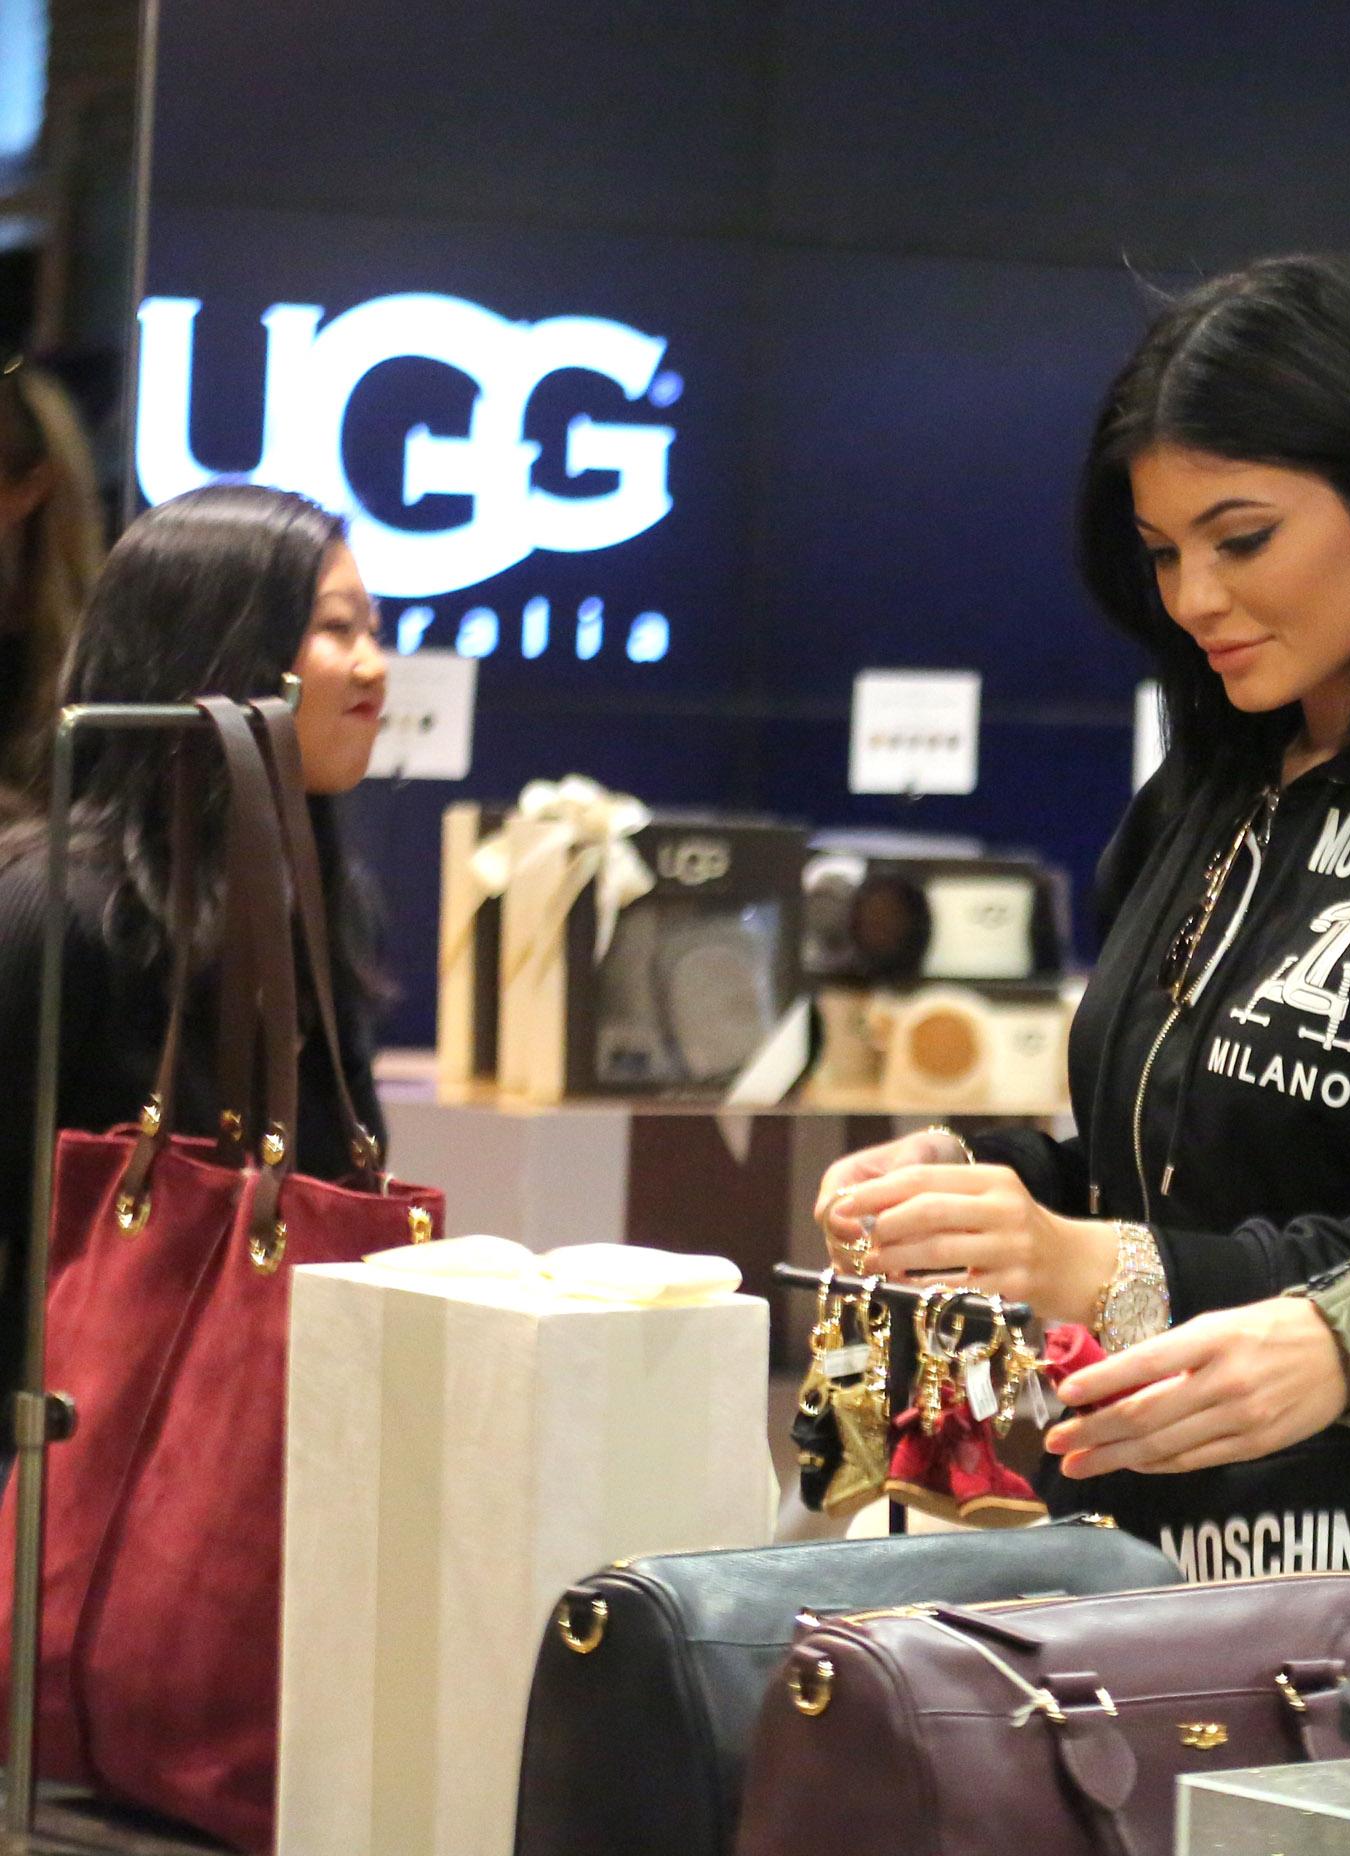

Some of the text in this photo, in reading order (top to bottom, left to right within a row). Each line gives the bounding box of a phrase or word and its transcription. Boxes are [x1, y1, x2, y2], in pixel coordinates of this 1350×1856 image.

[136, 291, 676, 598] UGG
[396, 595, 670, 662] ralia
[1207, 1036, 1350, 1108] MILANO
